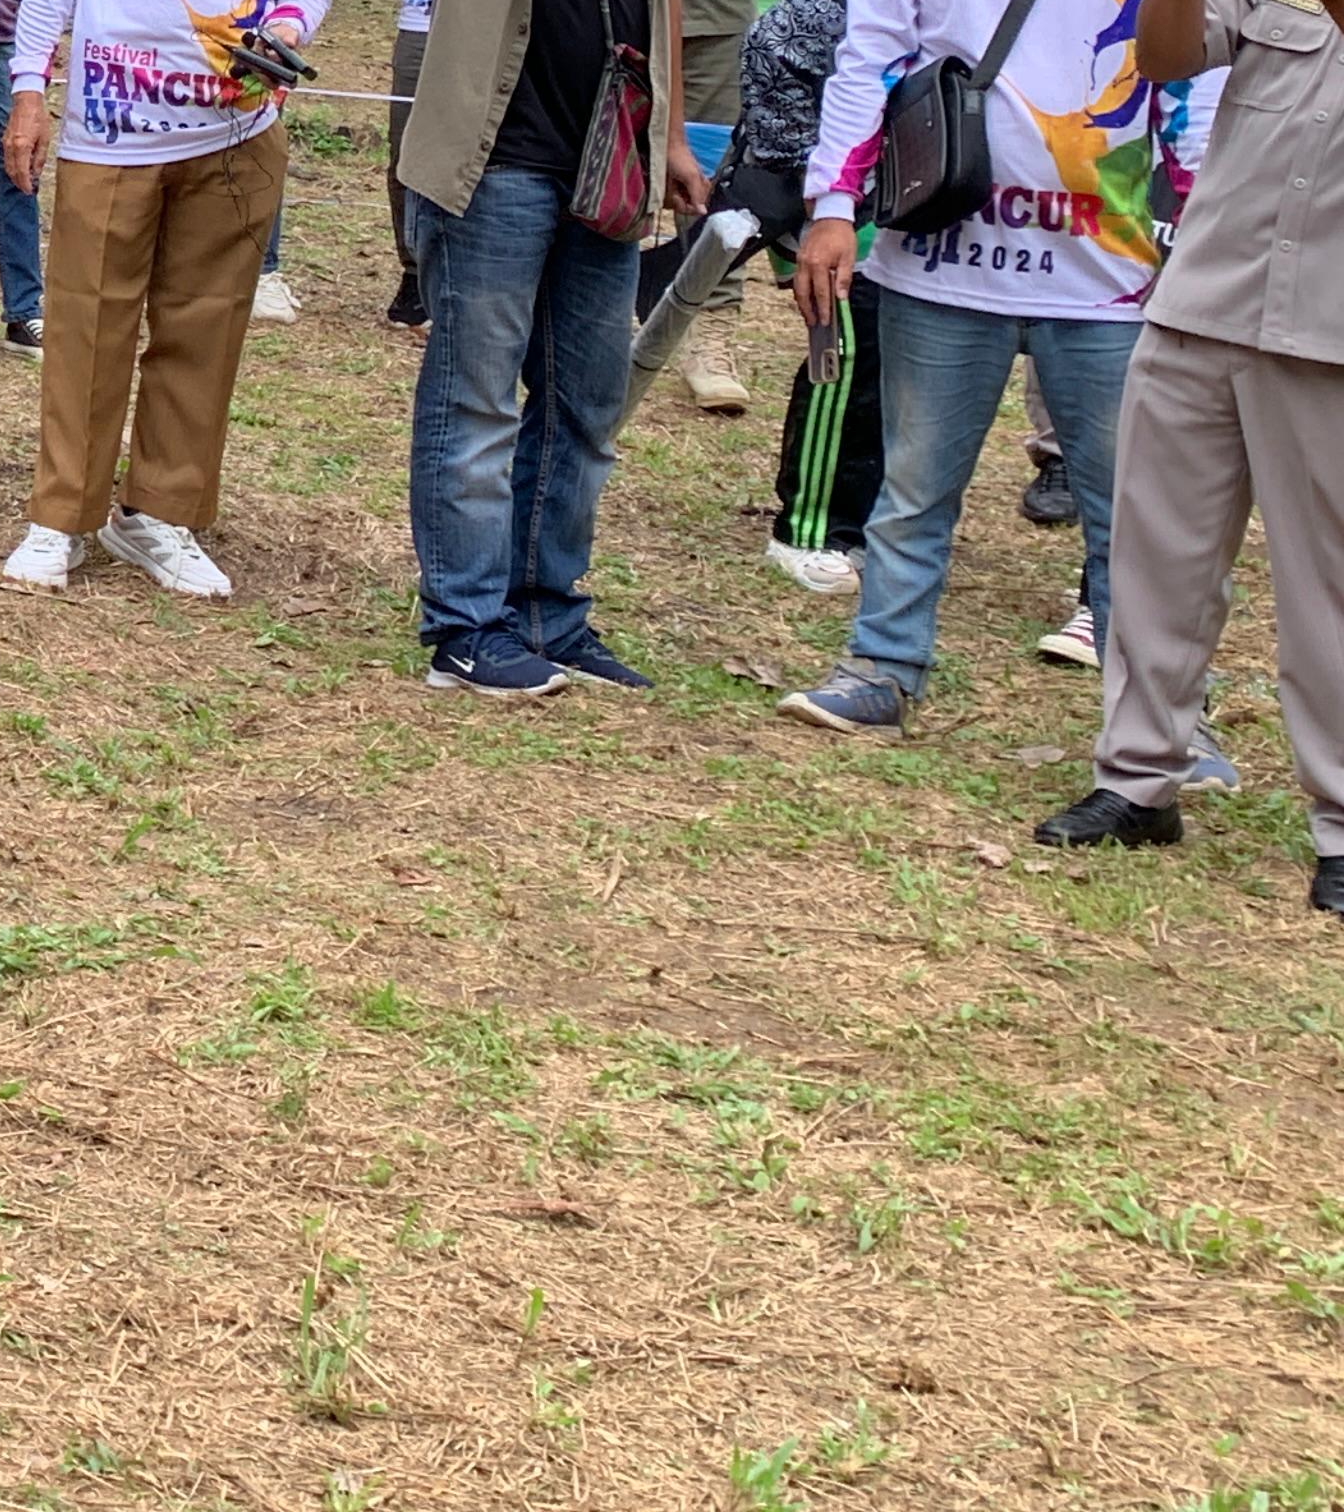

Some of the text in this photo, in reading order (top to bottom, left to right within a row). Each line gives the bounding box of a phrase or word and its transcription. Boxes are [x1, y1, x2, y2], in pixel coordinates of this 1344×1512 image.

[84, 39, 158, 67] Festival
[84, 98, 136, 145] AJI
[967, 243, 1054, 274] 2024
